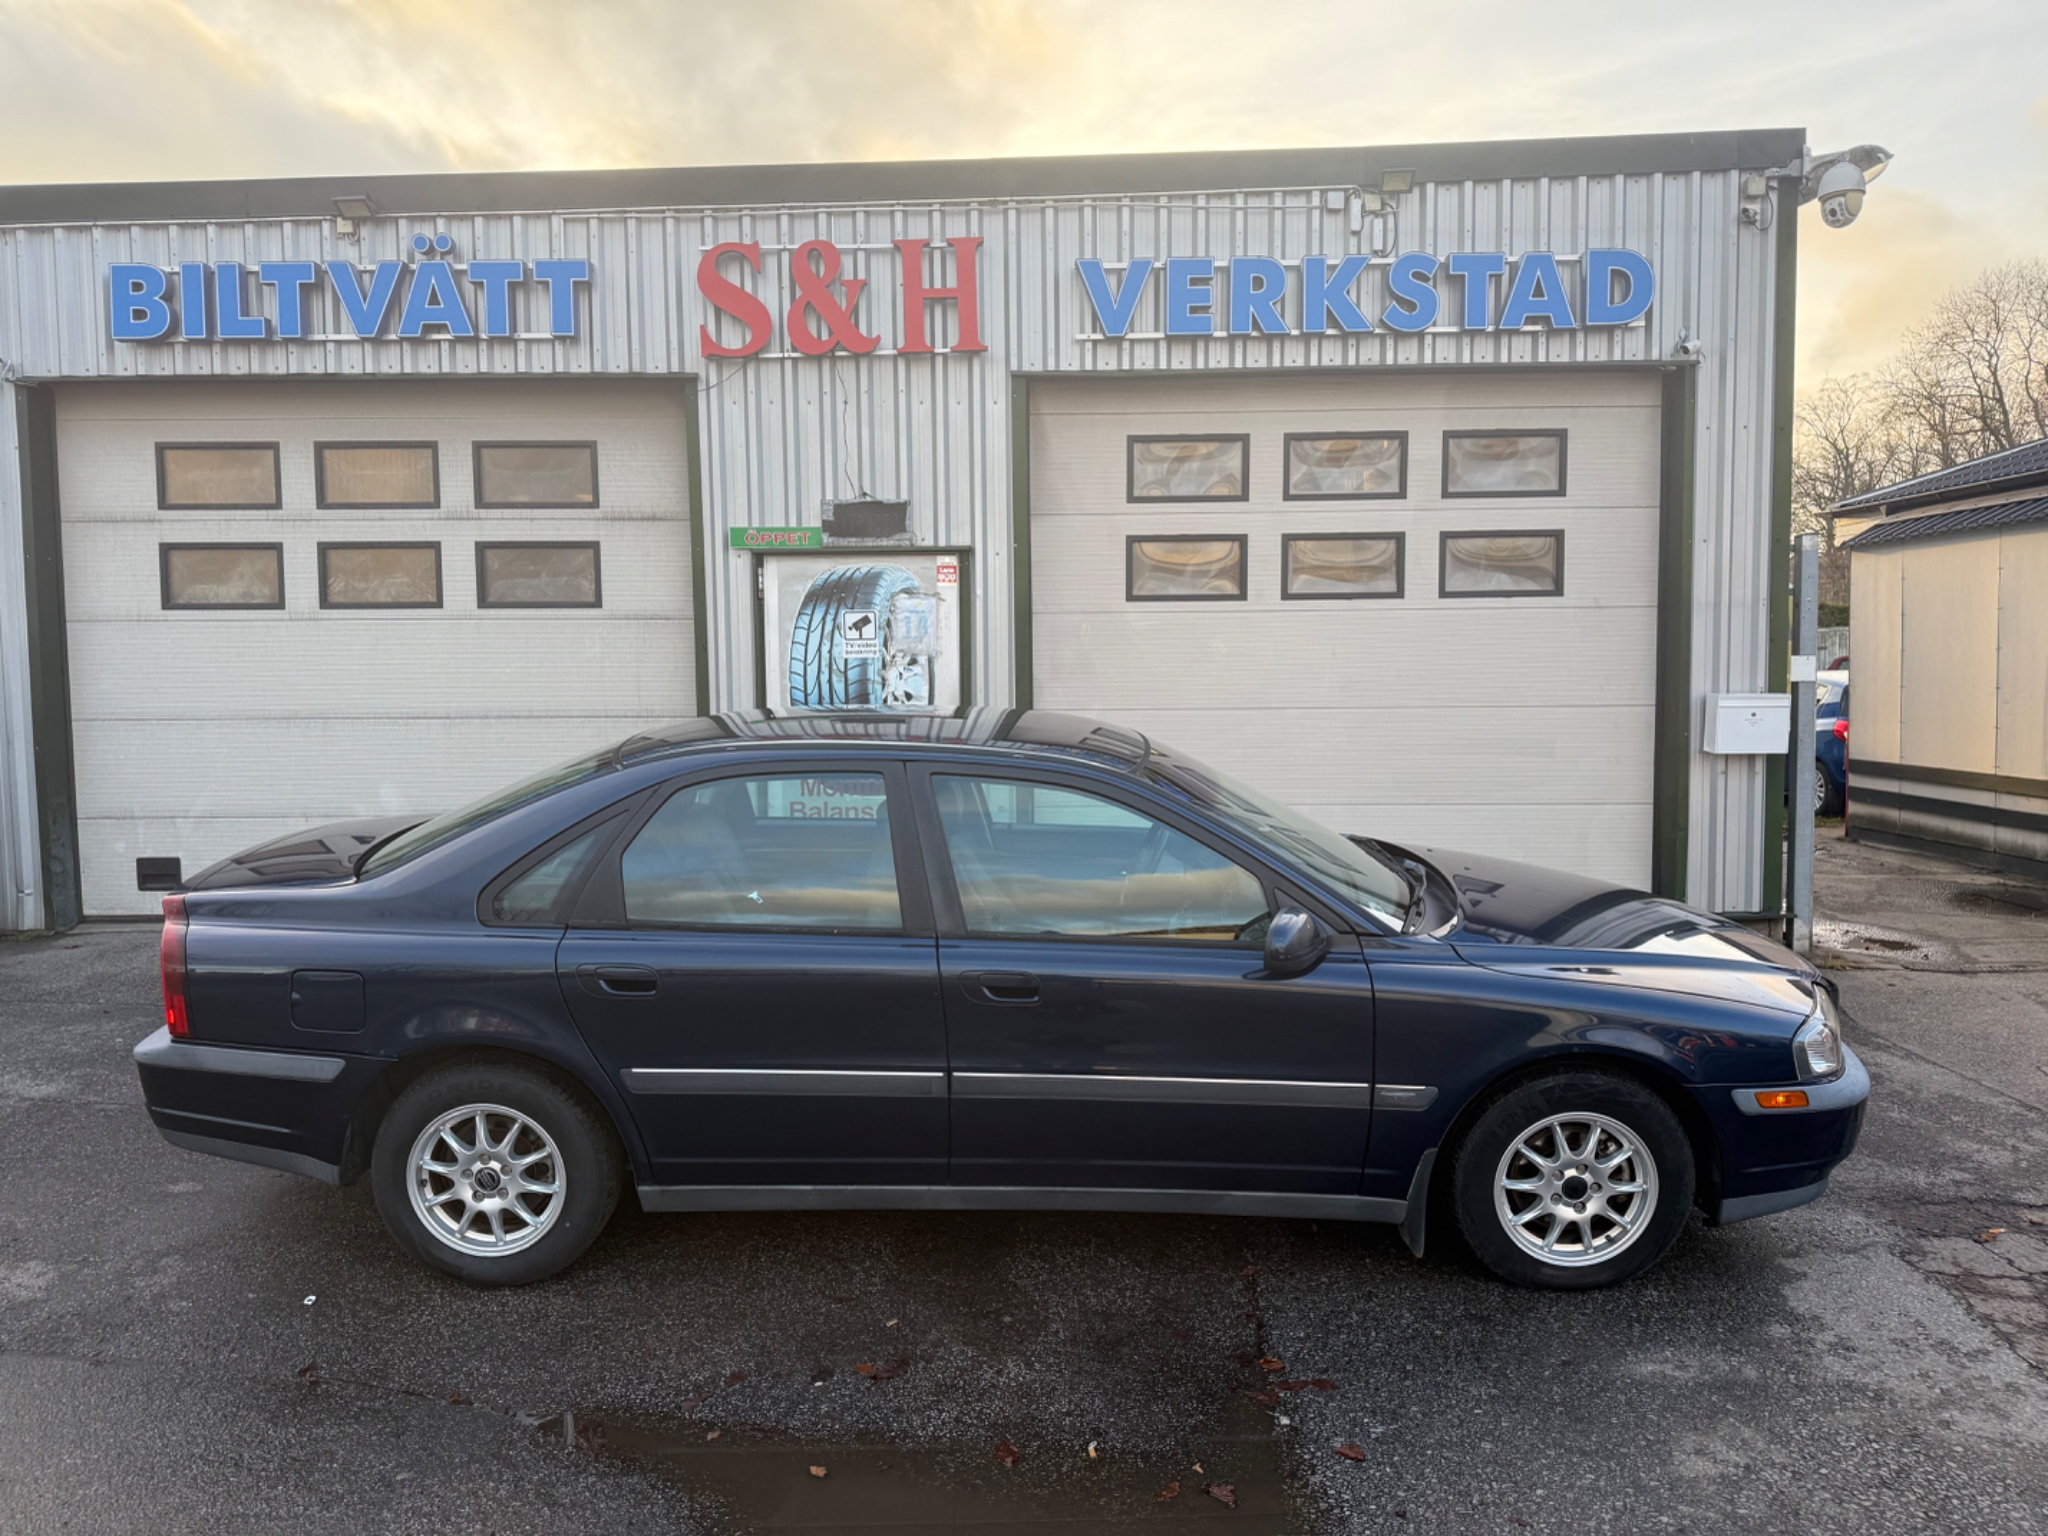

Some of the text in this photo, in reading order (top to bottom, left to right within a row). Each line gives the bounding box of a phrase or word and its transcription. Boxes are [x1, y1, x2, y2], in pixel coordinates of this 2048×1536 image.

[108, 233, 592, 342] BILTVÄTT
[697, 237, 988, 358] S&H
[1075, 248, 1655, 337] VERKSTAD
[744, 529, 811, 545] ÖPPET
